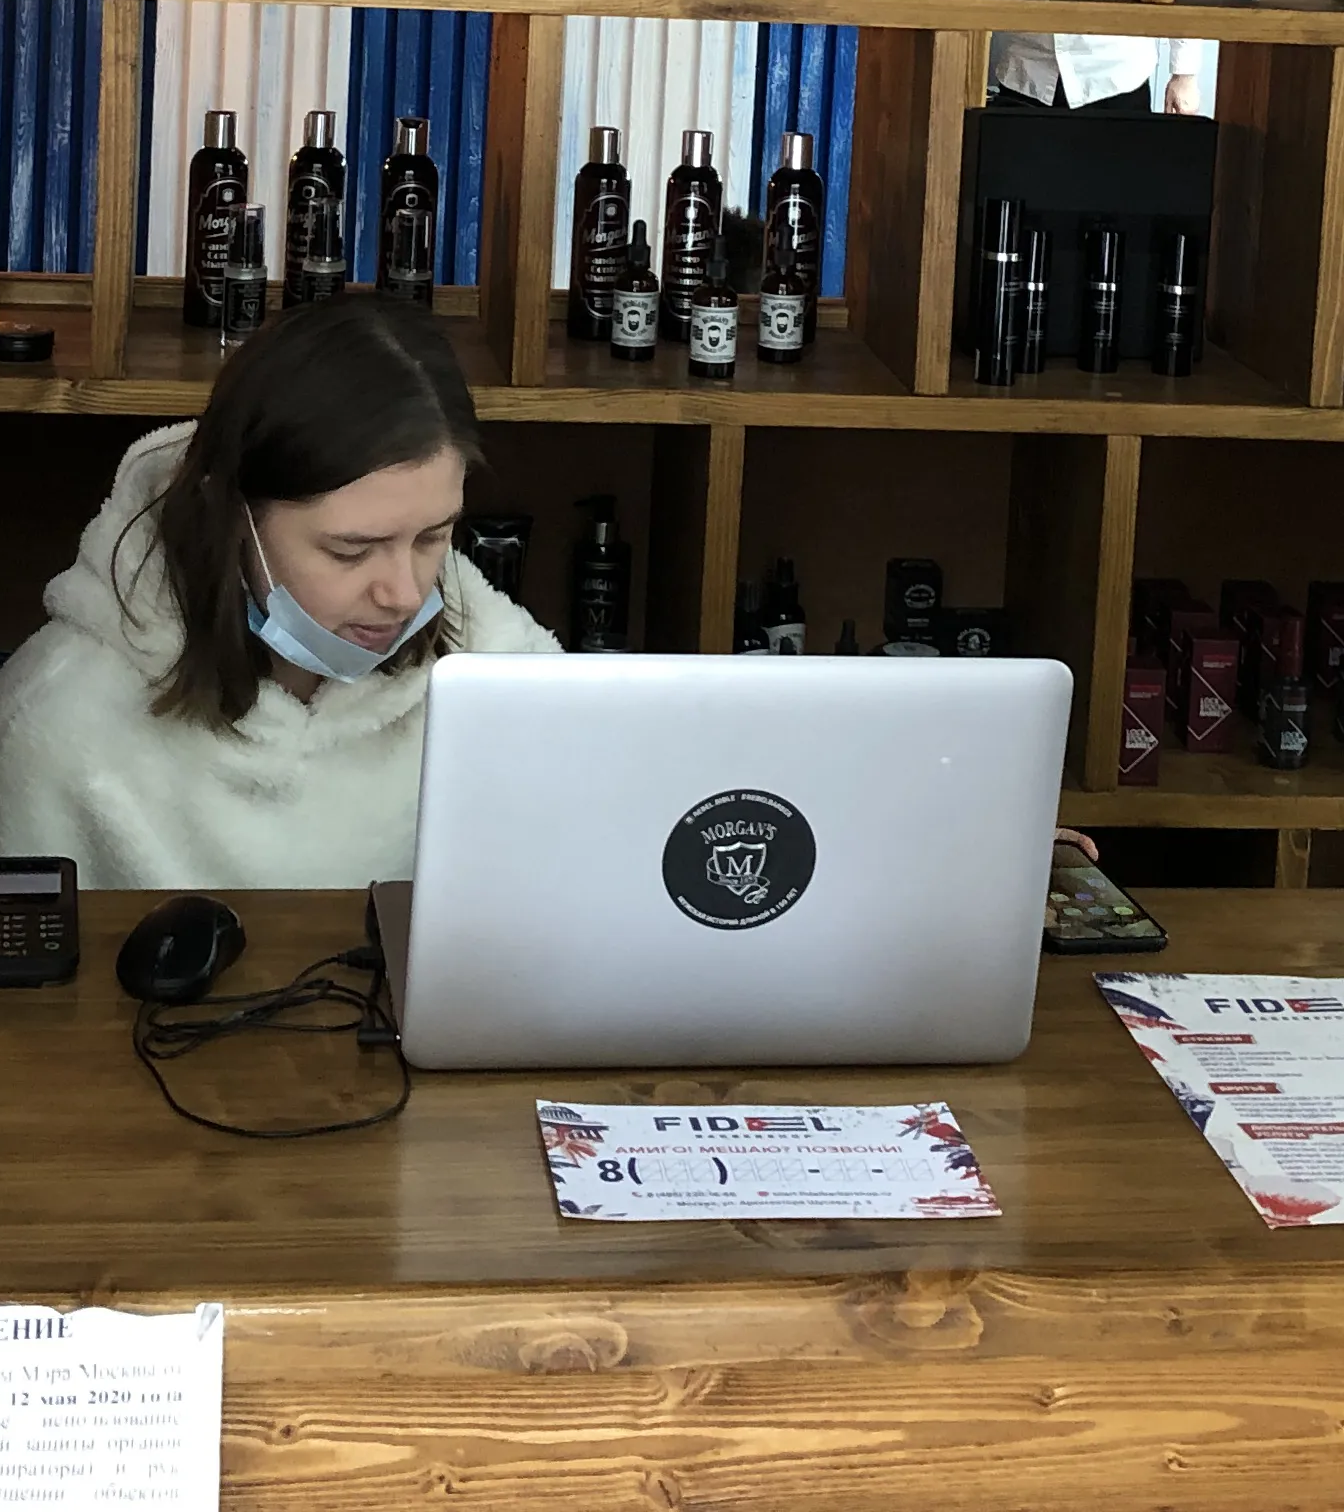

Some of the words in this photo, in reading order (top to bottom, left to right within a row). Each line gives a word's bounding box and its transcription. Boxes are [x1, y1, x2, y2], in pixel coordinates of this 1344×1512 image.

[700, 819, 779, 845] MORGAN'S
[726, 854, 754, 877] M
[654, 1116, 842, 1132] FIDEL
[615, 1144, 693, 1155] АМИГО!
[699, 1144, 791, 1155] МЕШАЮ?
[797, 1143, 903, 1155] ПОЗВОНИ!
[10, 1391, 30, 1407] 12
[40, 1394, 77, 1407] мая
[87, 1389, 132, 1405] 2020
